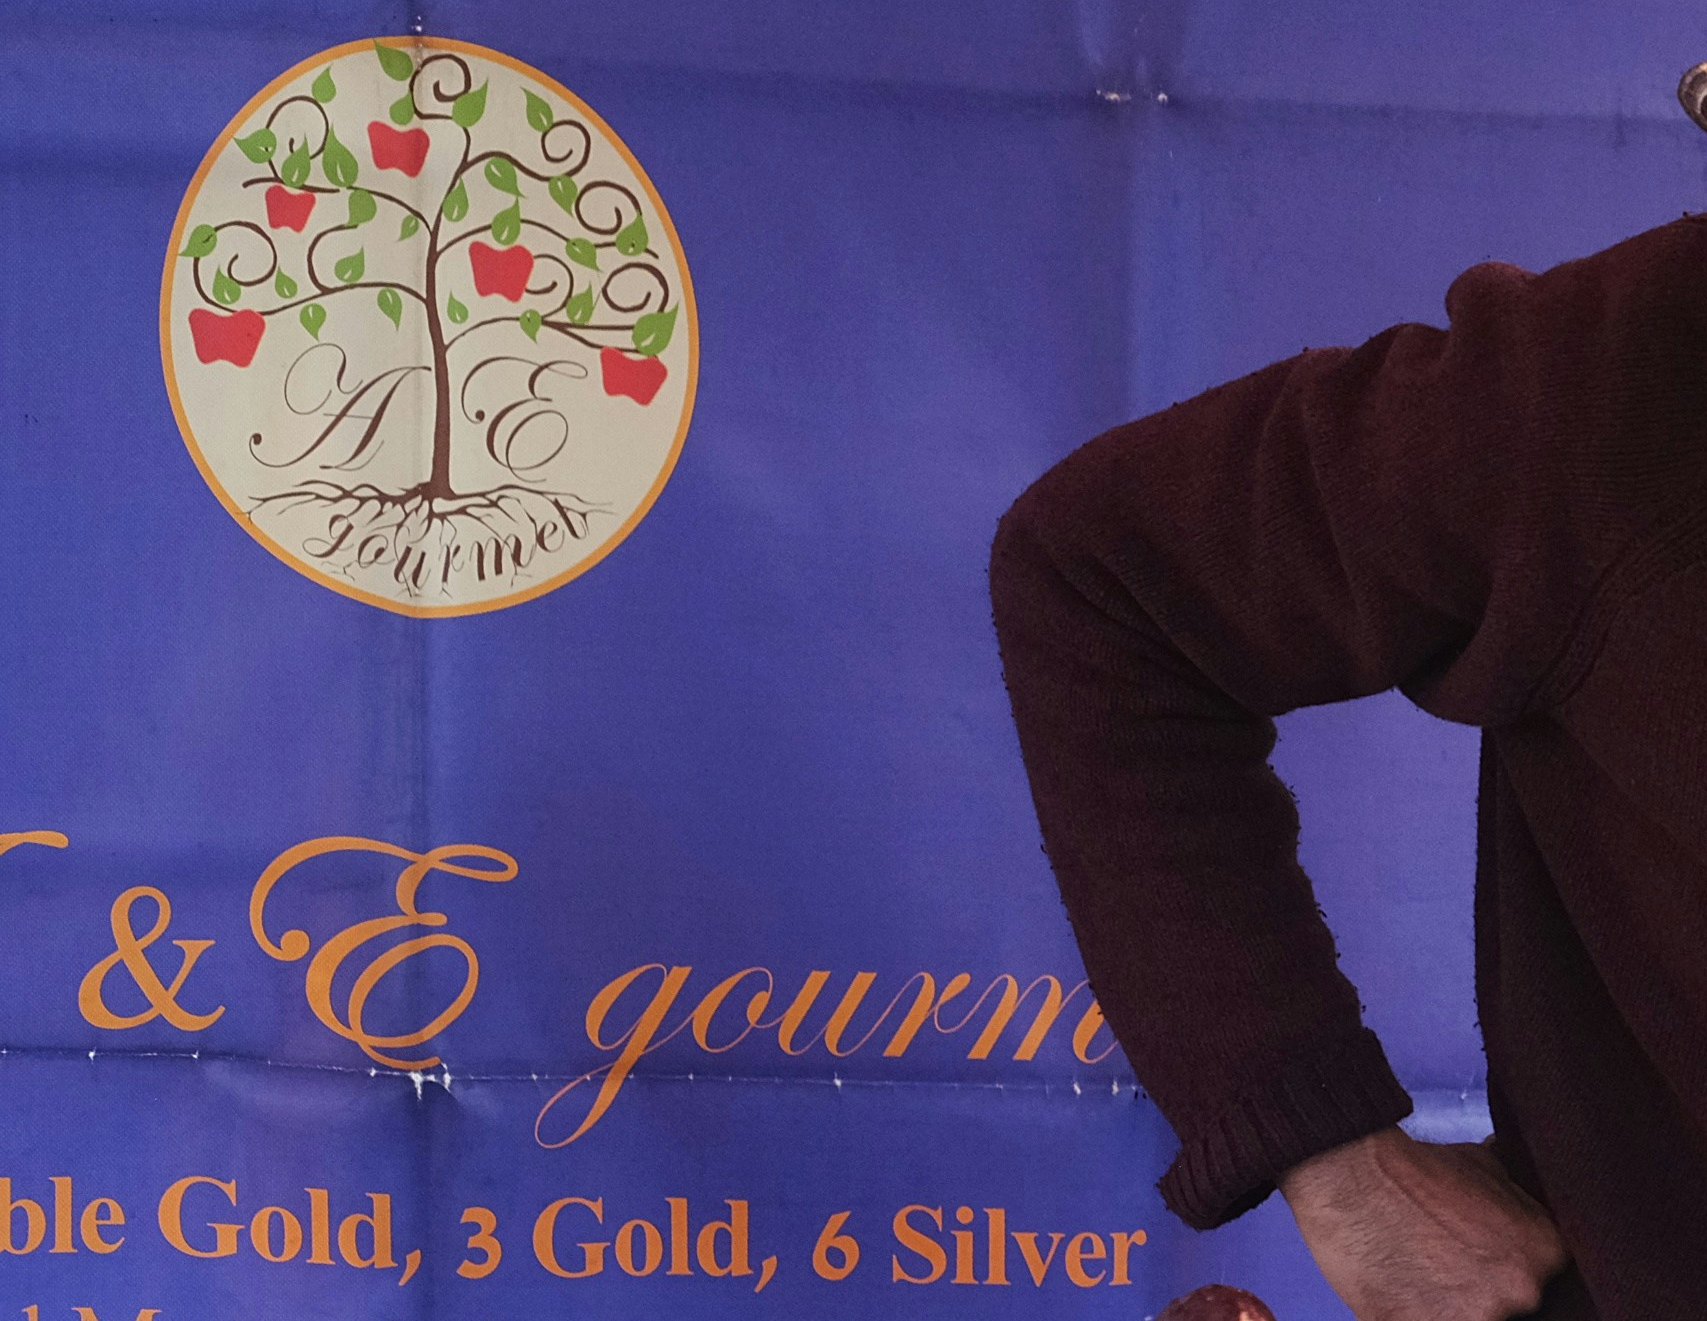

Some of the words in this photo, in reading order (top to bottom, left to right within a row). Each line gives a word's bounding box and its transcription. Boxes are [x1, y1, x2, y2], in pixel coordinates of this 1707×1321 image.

[79, 885, 226, 1032] &
[250, 835, 518, 1070] E
[535, 961, 1118, 1149] gourm
[0, 1177, 126, 1254] ble
[158, 1176, 422, 1286] Gold,
[456, 1207, 502, 1279] 3
[532, 1196, 778, 1292] Gold,
[812, 1210, 860, 1280] 6
[892, 1204, 1148, 1287] Silver
